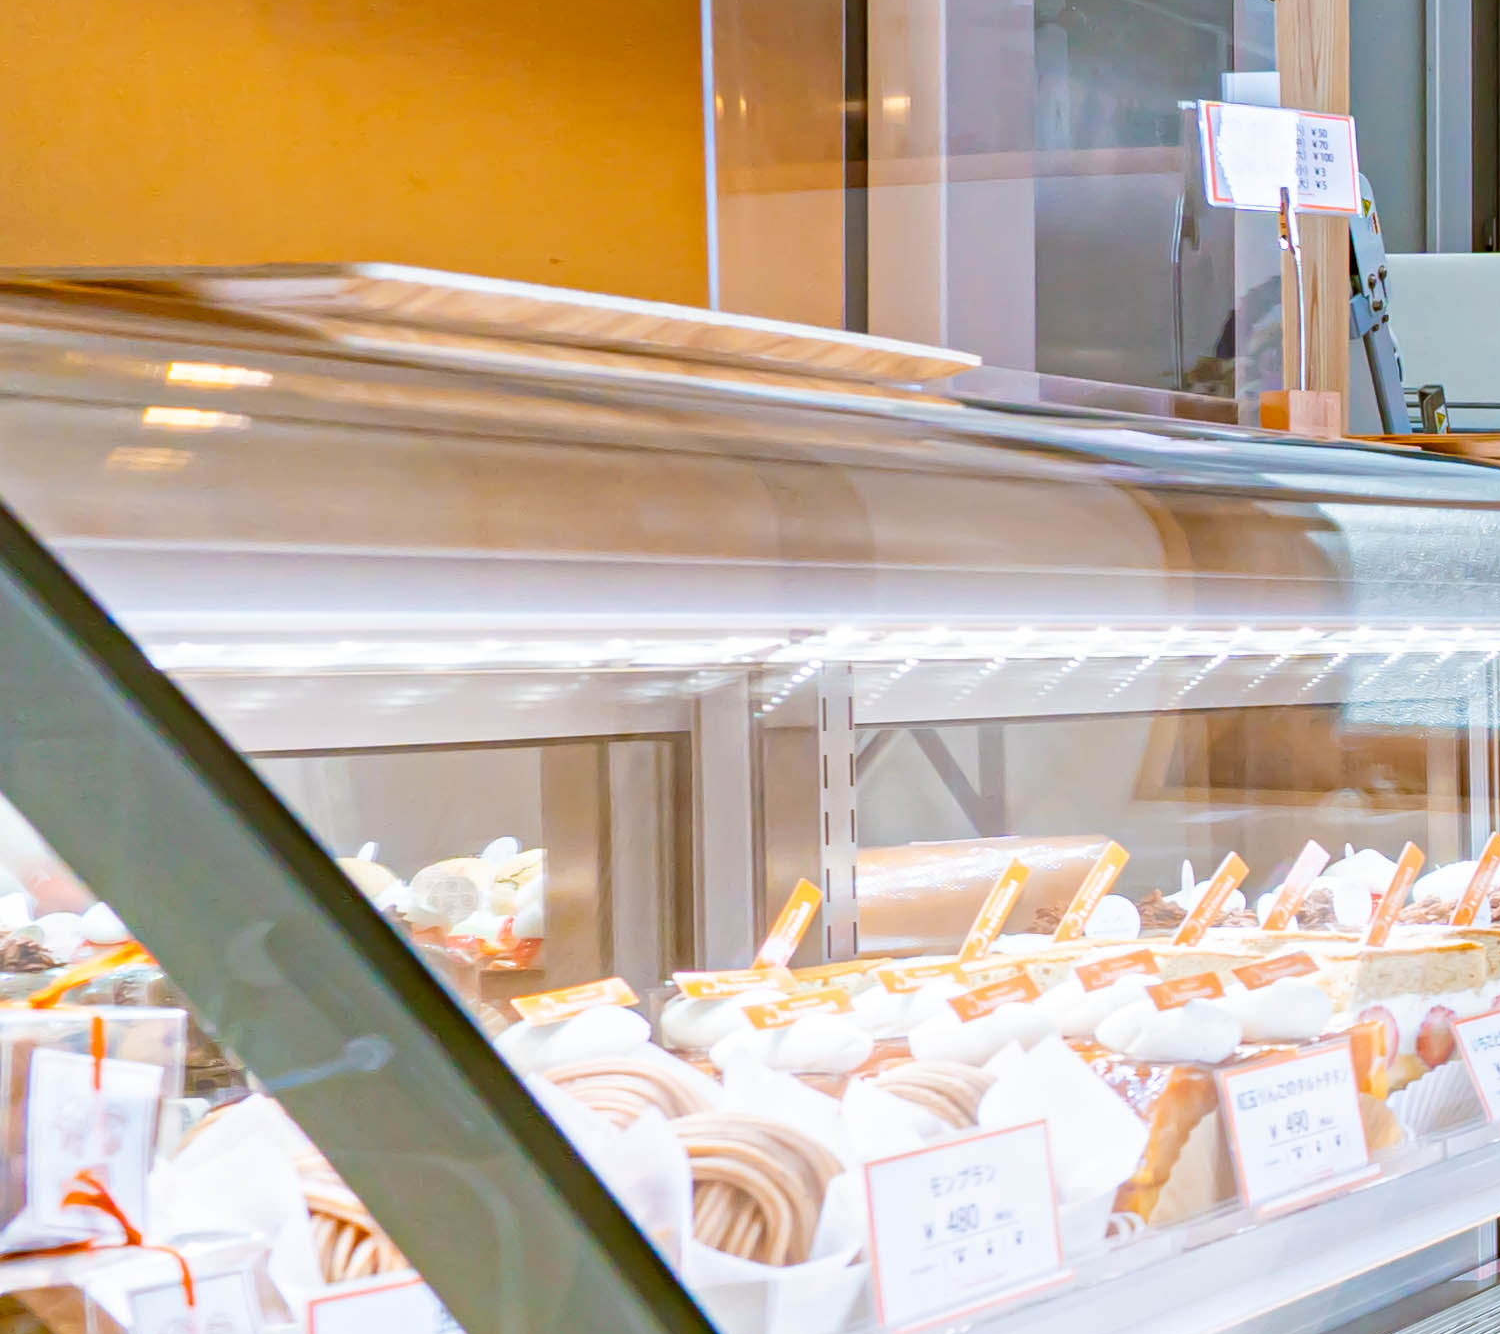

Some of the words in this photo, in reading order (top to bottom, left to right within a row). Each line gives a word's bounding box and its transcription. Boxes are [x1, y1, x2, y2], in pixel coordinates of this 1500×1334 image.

[929, 1165, 996, 1199] モンブラン
